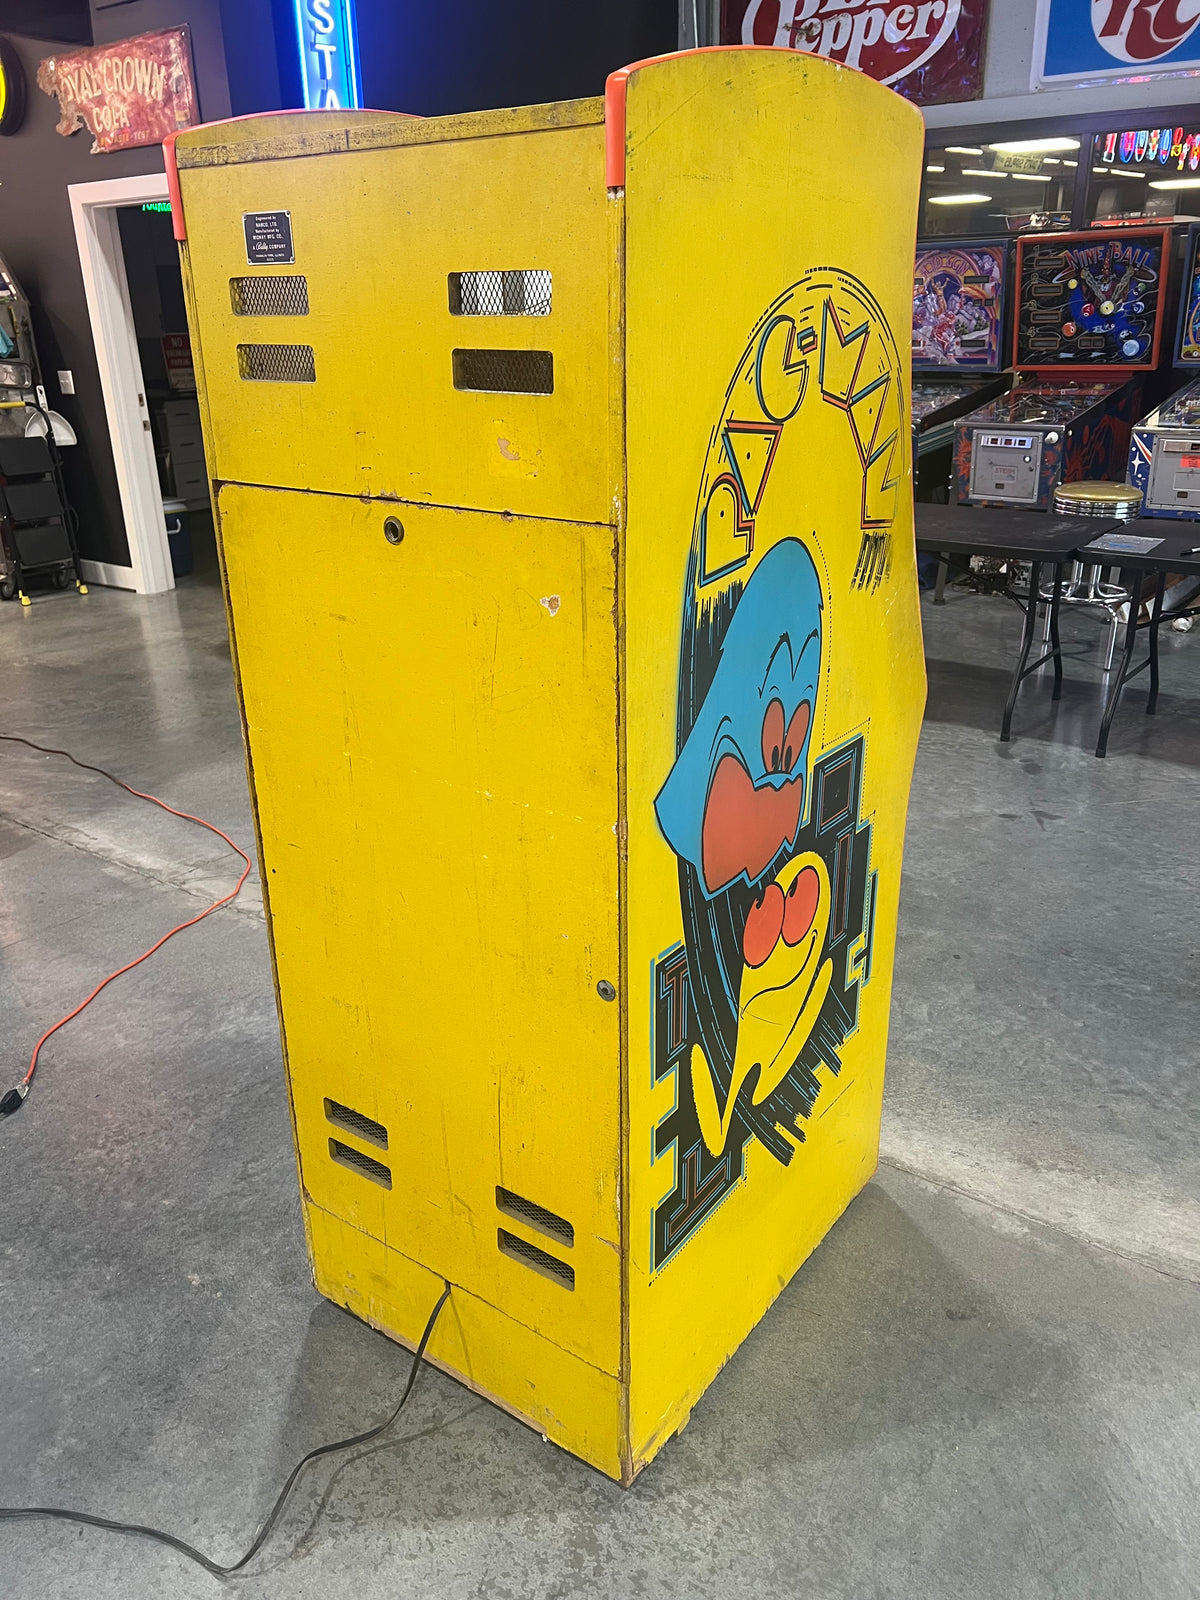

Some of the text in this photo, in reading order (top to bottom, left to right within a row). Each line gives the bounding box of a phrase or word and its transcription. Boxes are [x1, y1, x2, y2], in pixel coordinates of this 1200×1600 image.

[103, 56, 167, 103] CROWN
[92, 104, 130, 134] COLA
[256, 241, 268, 251] Bally
[1109, 241, 1150, 268] BALL
